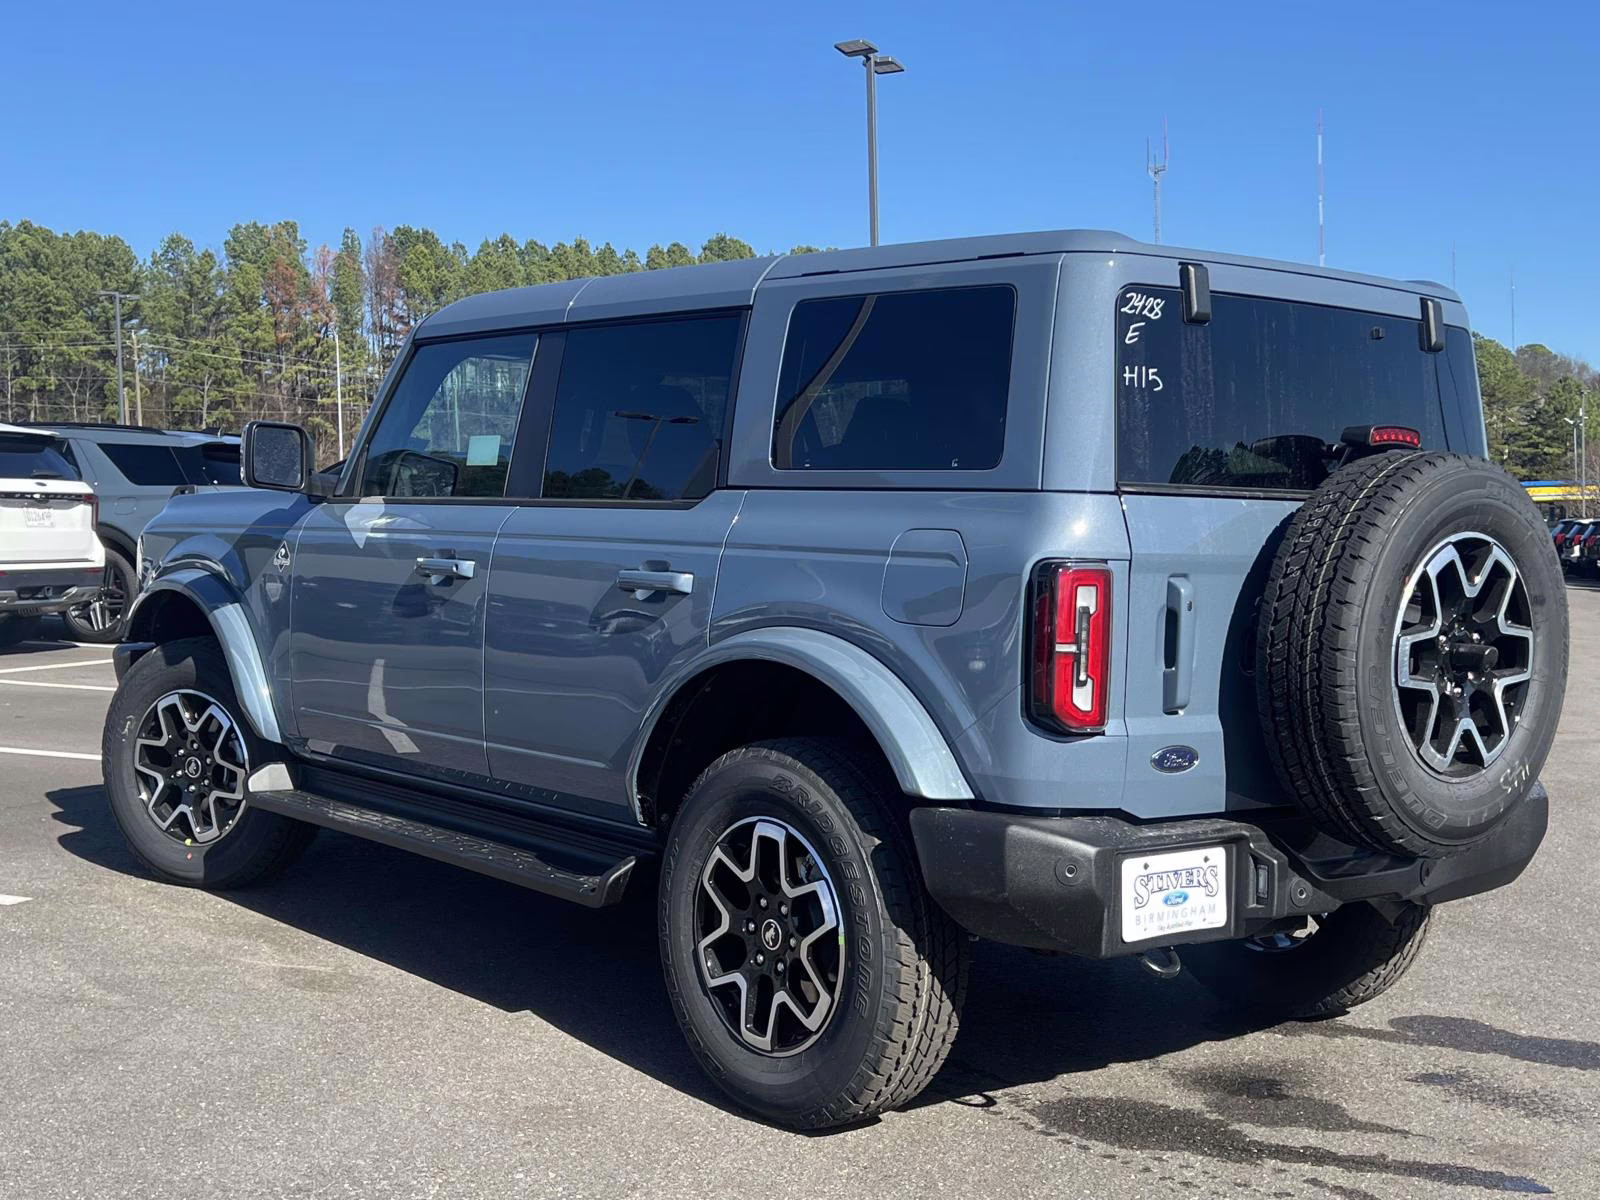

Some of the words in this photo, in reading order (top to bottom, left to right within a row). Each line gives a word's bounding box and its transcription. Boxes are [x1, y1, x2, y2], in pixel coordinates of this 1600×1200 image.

[1121, 291, 1166, 320] 2428
[1125, 322, 1146, 344] E
[1122, 364, 1164, 392] H15
[768, 772, 875, 1020] BRIDGESTONE
[1134, 866, 1218, 909] STIVERS
[1135, 903, 1216, 926] BIRMINGHAM
